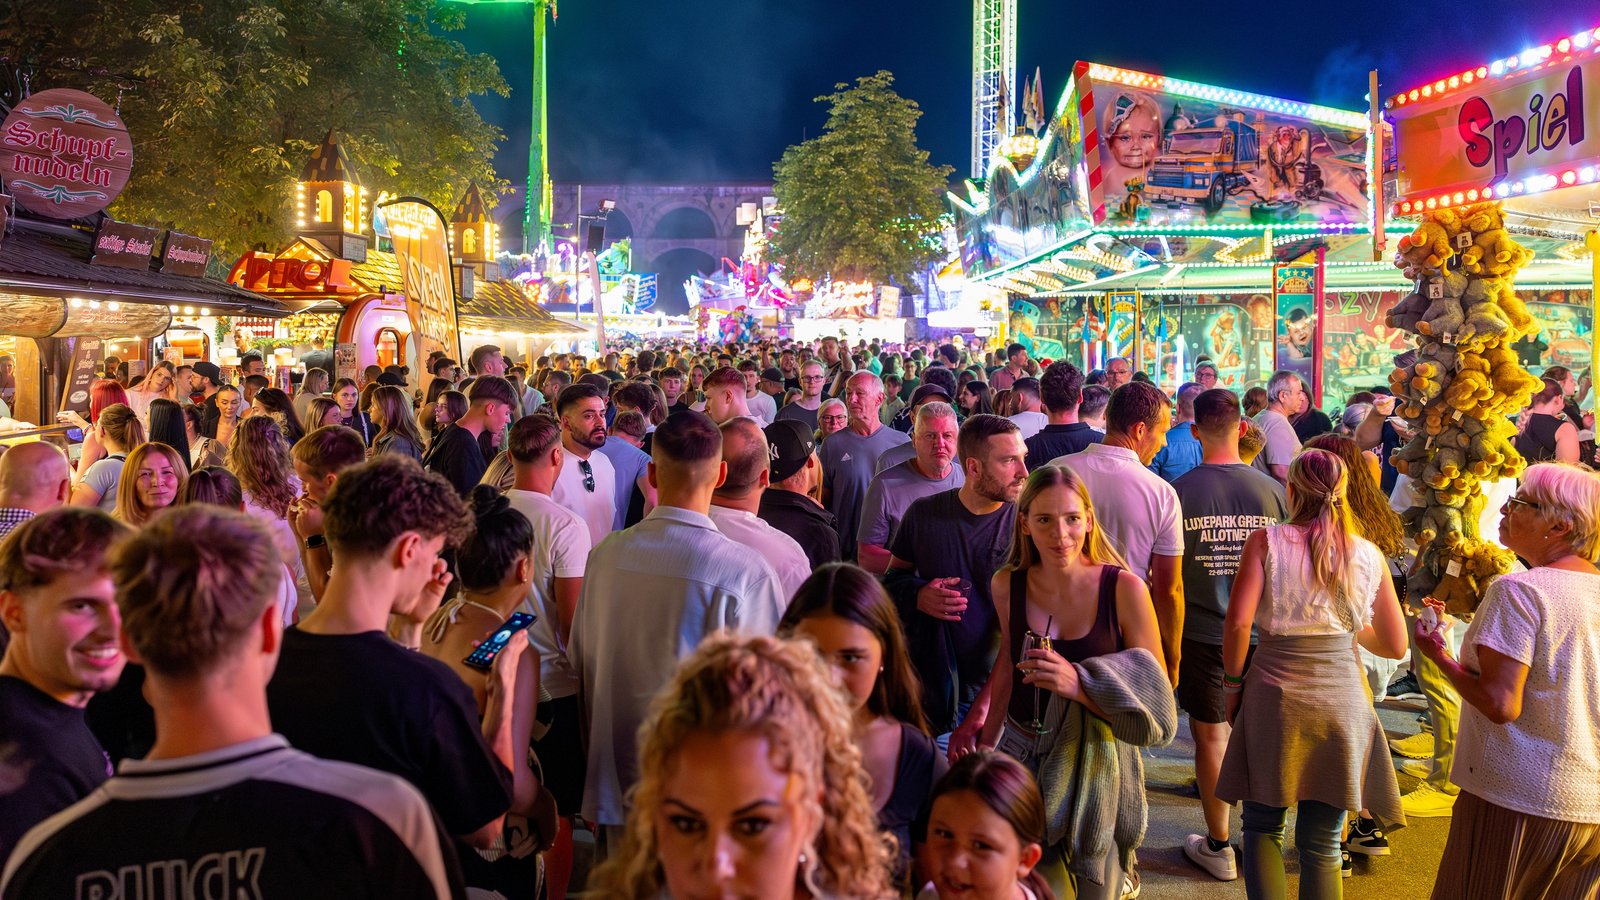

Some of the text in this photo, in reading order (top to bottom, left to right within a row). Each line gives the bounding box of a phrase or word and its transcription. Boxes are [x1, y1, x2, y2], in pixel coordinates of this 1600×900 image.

[5, 120, 127, 162] Schupf-
[1458, 64, 1585, 188] Spiel
[13, 153, 111, 187] nudeln
[227, 250, 338, 293] APEROL
[1184, 514, 1278, 531] LUXEPARK GREENS
[1200, 528, 1256, 542] ALLOTMEN
